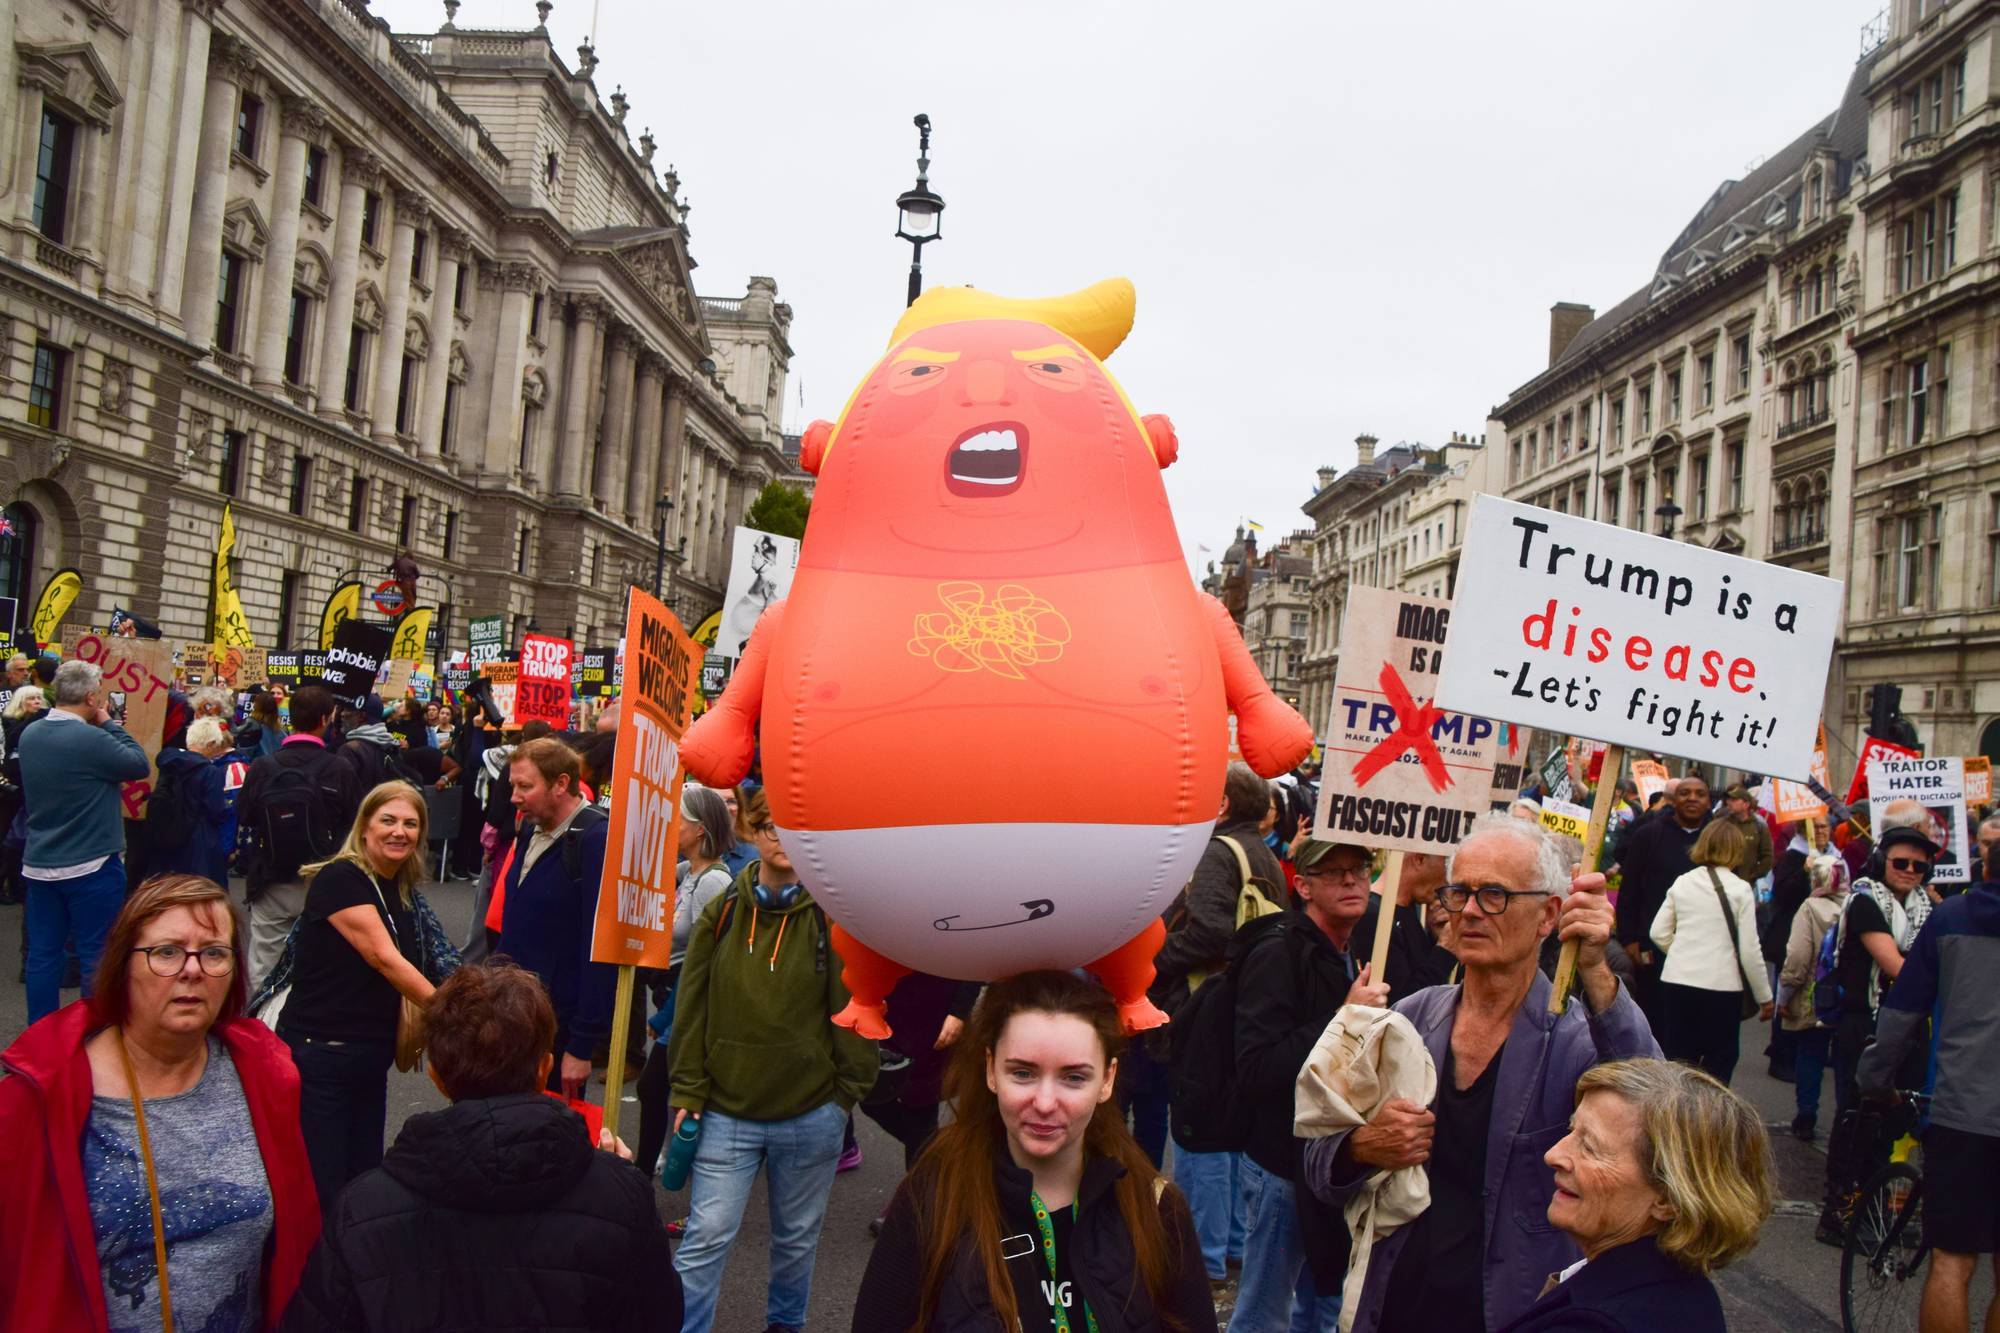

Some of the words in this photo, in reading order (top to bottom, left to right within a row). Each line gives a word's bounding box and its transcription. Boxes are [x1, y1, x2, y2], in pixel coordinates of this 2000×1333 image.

[1512, 517, 1693, 615] Trump
[1718, 575, 1753, 620] is
[1775, 602, 1799, 634] a
[471, 623, 487, 633] END
[487, 620, 501, 630] THE
[1397, 602, 1450, 644] MAG
[471, 631, 501, 641] GENOCIDE
[470, 643, 501, 661] STOP
[523, 639, 569, 664] STOP
[640, 612, 690, 689] MIGRANTS
[1522, 599, 1767, 701] disease.
[76, 635, 168, 702] OUST
[268, 656, 297, 665] RESIST
[304, 655, 326, 666] RESI
[327, 647, 377, 672] phobia.
[584, 655, 604, 667] RESIST
[1410, 646, 1427, 673] IS
[1430, 650, 1443, 675] A
[268, 666, 298, 675] SEXISM
[448, 670, 470, 679] EXPECT
[523, 659, 567, 680] TRUMP
[583, 669, 604, 681] SEXISM
[703, 667, 724, 681] STOP
[448, 680, 471, 690] RESIST
[520, 681, 566, 705] STOP
[519, 702, 564, 719] FASCISM
[1627, 687, 1724, 739] fight
[1736, 713, 1776, 749] it!
[1342, 699, 1493, 746] TRUMP
[1345, 733, 1370, 744] MAKE
[632, 712, 679, 786] TRUMP
[1450, 749, 1482, 759] AGAIN!
[1869, 744, 1914, 763] STO
[1882, 759, 1948, 774] TRAITOR
[1889, 776, 1943, 790] HATER
[1920, 792, 1962, 801] DICTATOR
[1327, 793, 1421, 839] FASCIST
[1421, 806, 1476, 844] CULT
[1543, 813, 1558, 826] NO
[1562, 818, 1576, 831] TO
[621, 777, 674, 889] NOT
